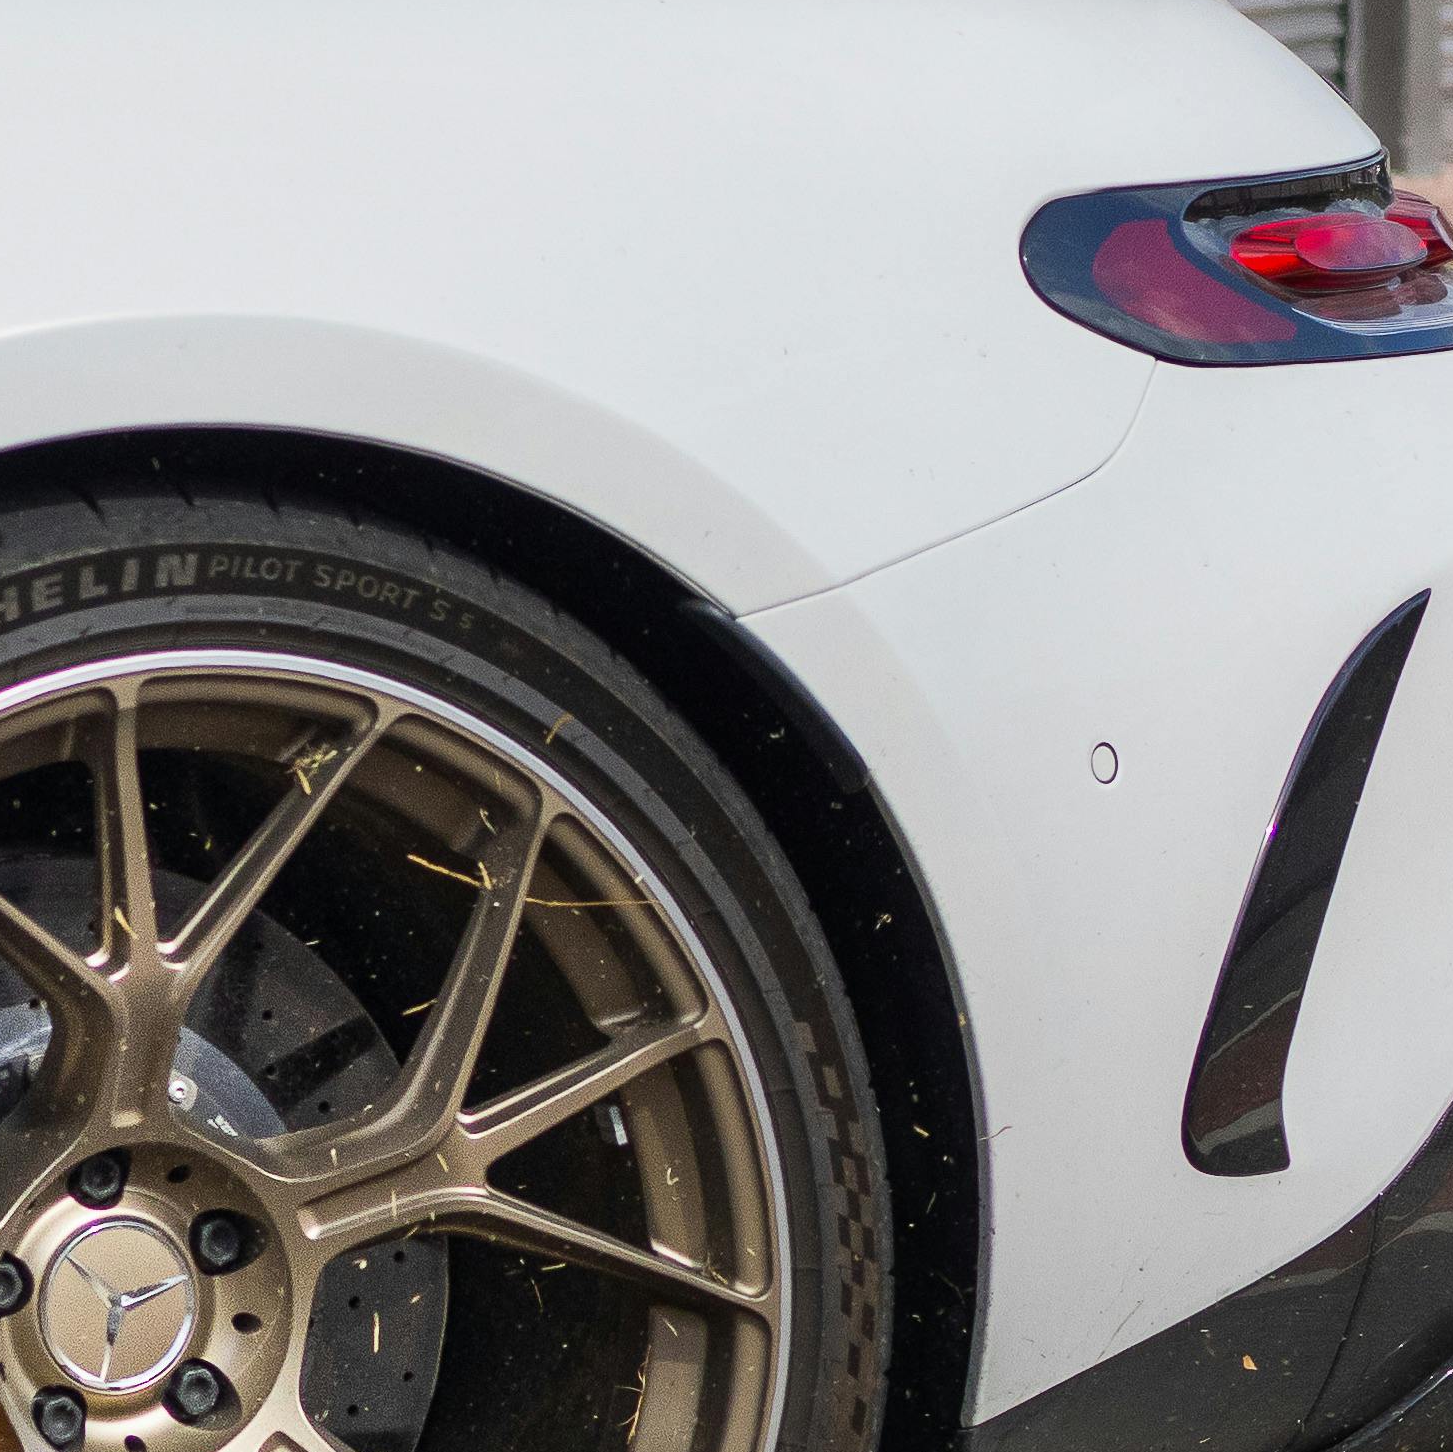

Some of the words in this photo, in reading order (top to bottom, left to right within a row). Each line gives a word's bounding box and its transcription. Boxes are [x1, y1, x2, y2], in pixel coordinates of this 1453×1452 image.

[208, 554, 303, 582] PILOT
[311, 564, 422, 610] SPORT
[429, 599, 451, 622] S
